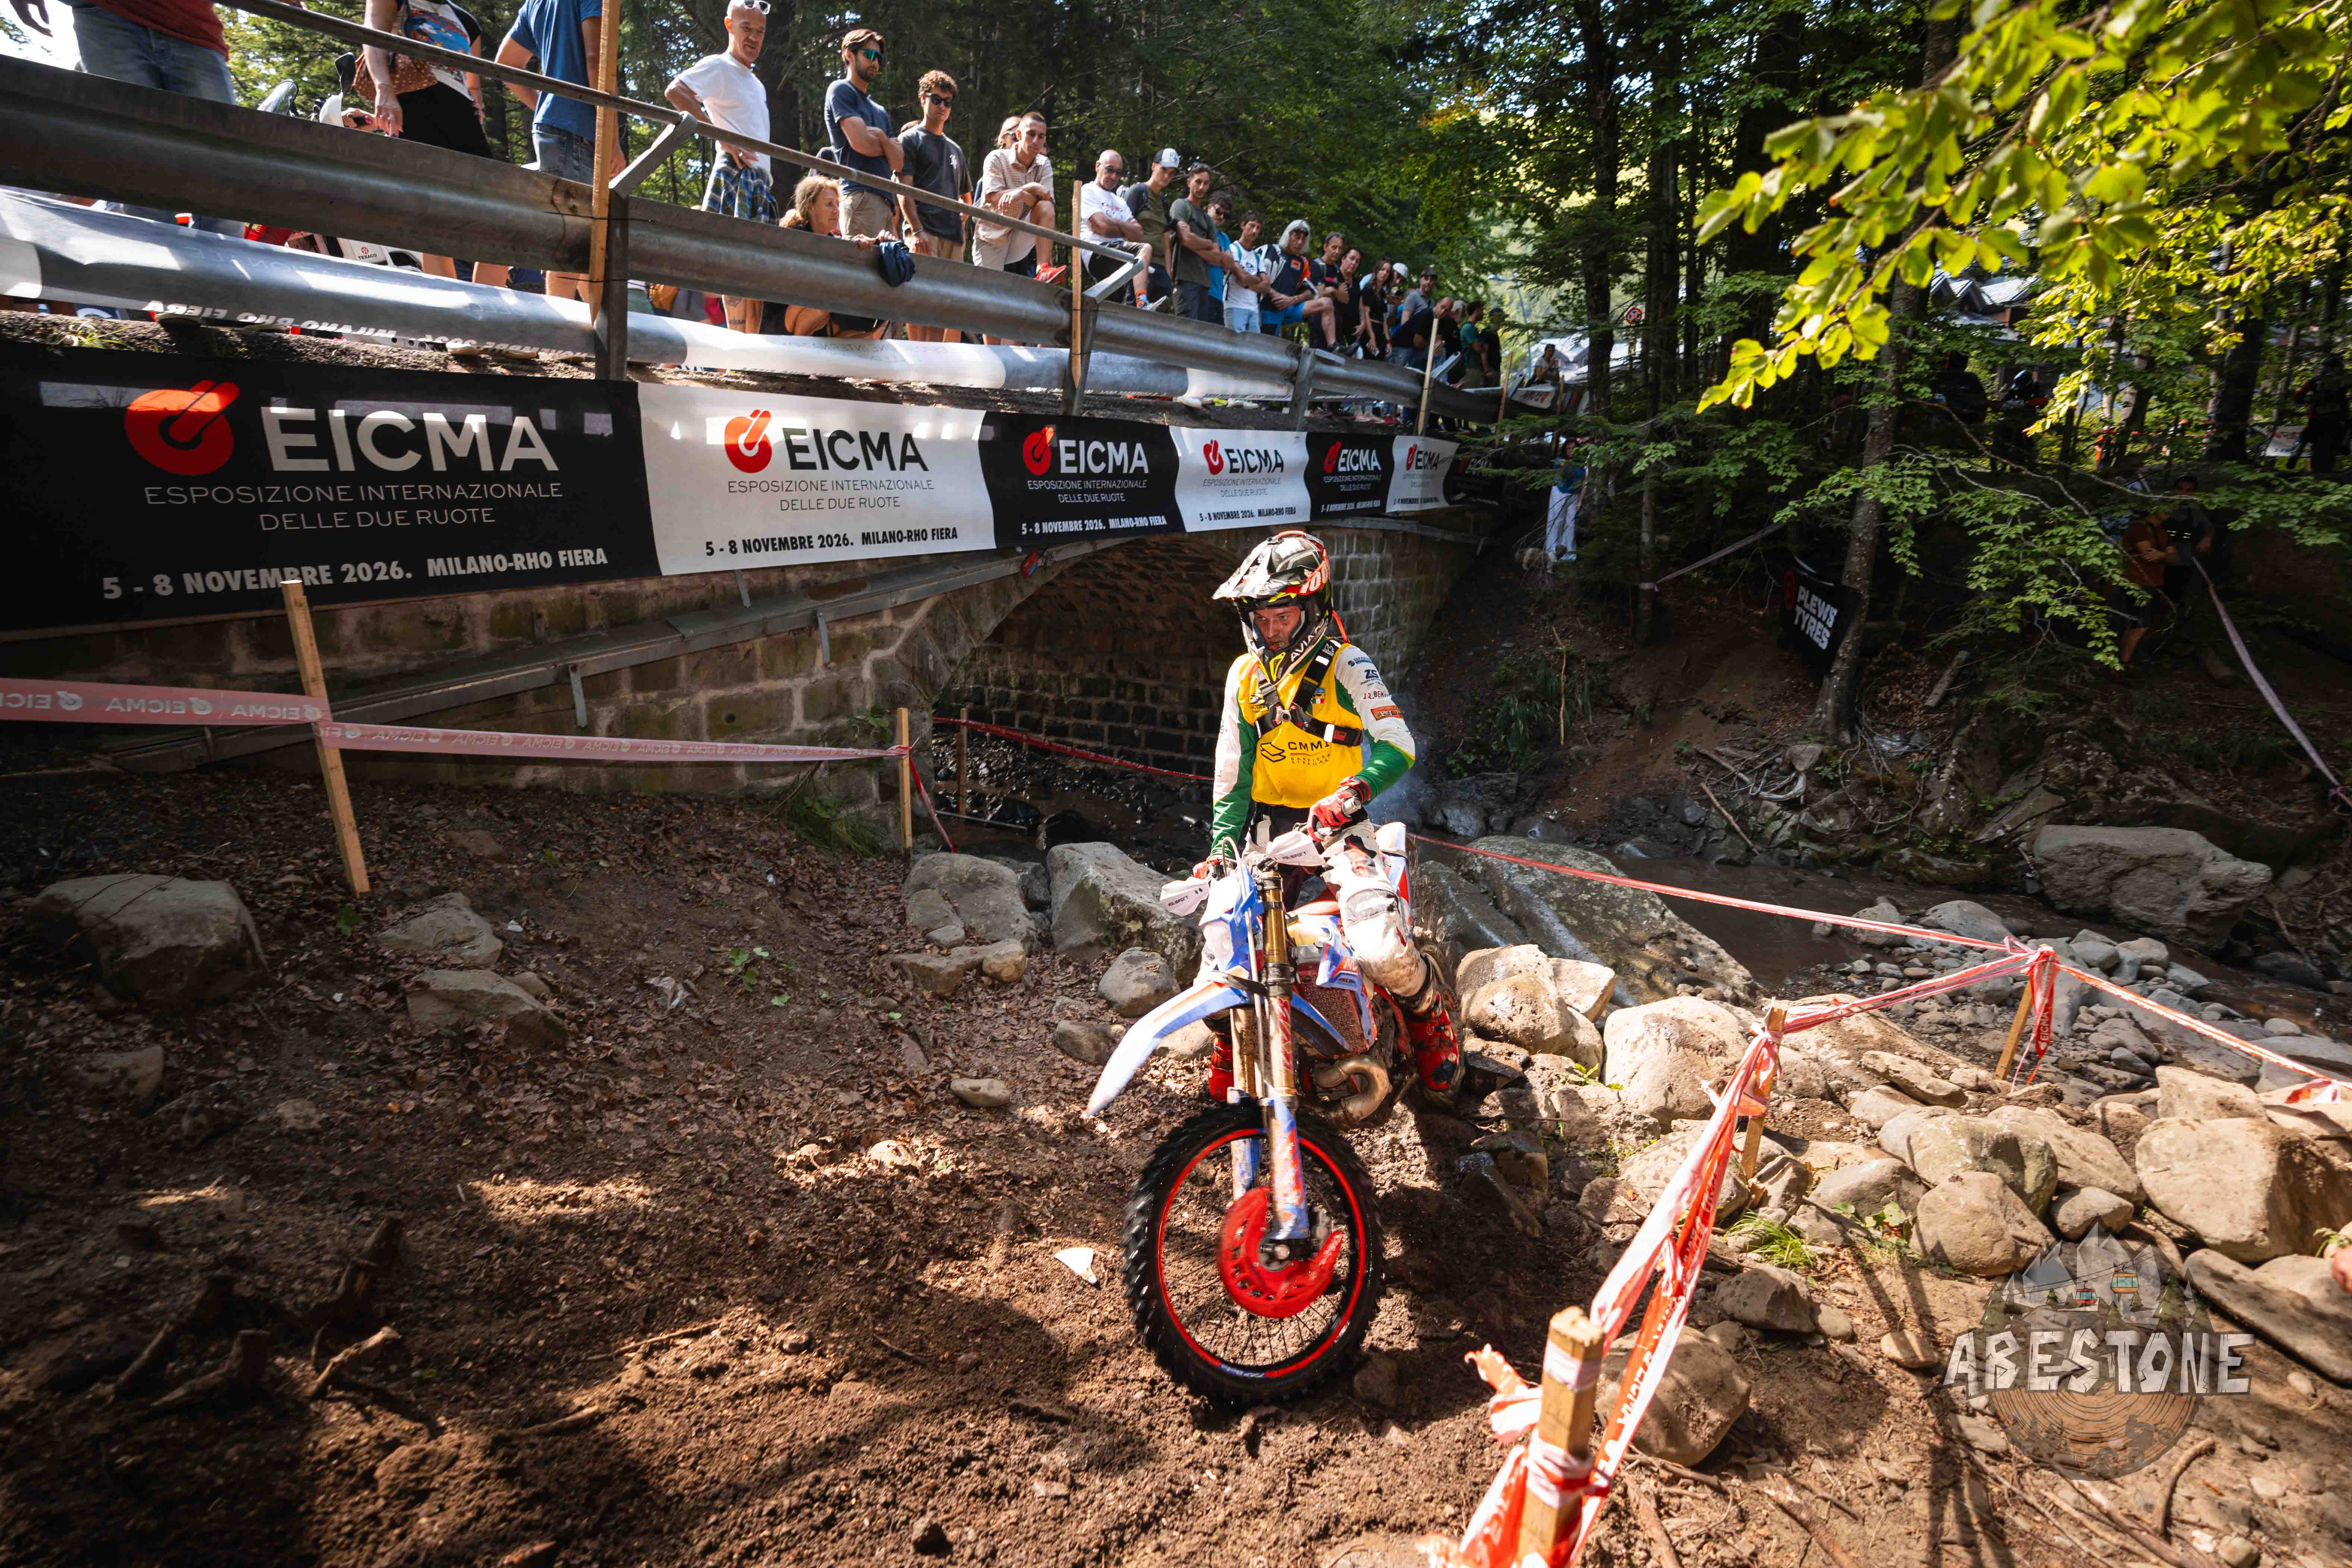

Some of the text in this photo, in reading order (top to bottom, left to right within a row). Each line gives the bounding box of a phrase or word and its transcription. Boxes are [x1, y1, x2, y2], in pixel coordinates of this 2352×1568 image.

[260, 406, 560, 472] EICMA
[782, 427, 929, 471] EICMA
[1059, 439, 1149, 474] EICMA
[1224, 449, 1284, 474] EICMA
[1338, 449, 1381, 472] EICMA
[145, 483, 563, 505] ESPOSIZIONE INTERNAZIONALE
[728, 479, 934, 493] ESPOSIZIONE INTERNAZIONALE
[1027, 480, 1147, 490] ESPOSIZIONE INTERNAZIONALE
[780, 496, 901, 511] DELLE DUE RUOTE
[1058, 493, 1125, 503] DELLE DUE RUOTE
[261, 506, 496, 531] DELLE DUE RUOTE
[1021, 523, 1027, 535] 5
[1034, 522, 1040, 534] 8
[1042, 520, 1083, 534] NOVEMBRE
[1084, 519, 1106, 531] 2026.
[1109, 516, 1148, 529] MILANO-RHO
[1149, 515, 1167, 526] FIERA
[1199, 513, 1203, 522] 5
[1213, 510, 1240, 521] NOVEMBRE
[1241, 509, 1256, 519] 2026.
[1285, 506, 1296, 515] FIERA
[705, 541, 714, 556] 5
[729, 540, 738, 554] 8
[742, 535, 814, 554] NOVEMBRE
[817, 533, 854, 549] 2026.
[861, 528, 928, 545] MILANO-RHO
[931, 527, 958, 541] FIERA
[103, 577, 121, 600] 5
[154, 574, 174, 596] 8
[183, 564, 333, 594] NOVEMBRE
[341, 561, 412, 584] 2026.
[427, 552, 553, 578] MILANO-RHO
[558, 548, 608, 568] FIERA
[1797, 585, 1838, 628] PLEWS
[1794, 604, 1831, 650] TYRES
[1168, 895, 1188, 907] POLISPORT
[2040, 1011, 2050, 1041] EICMA
